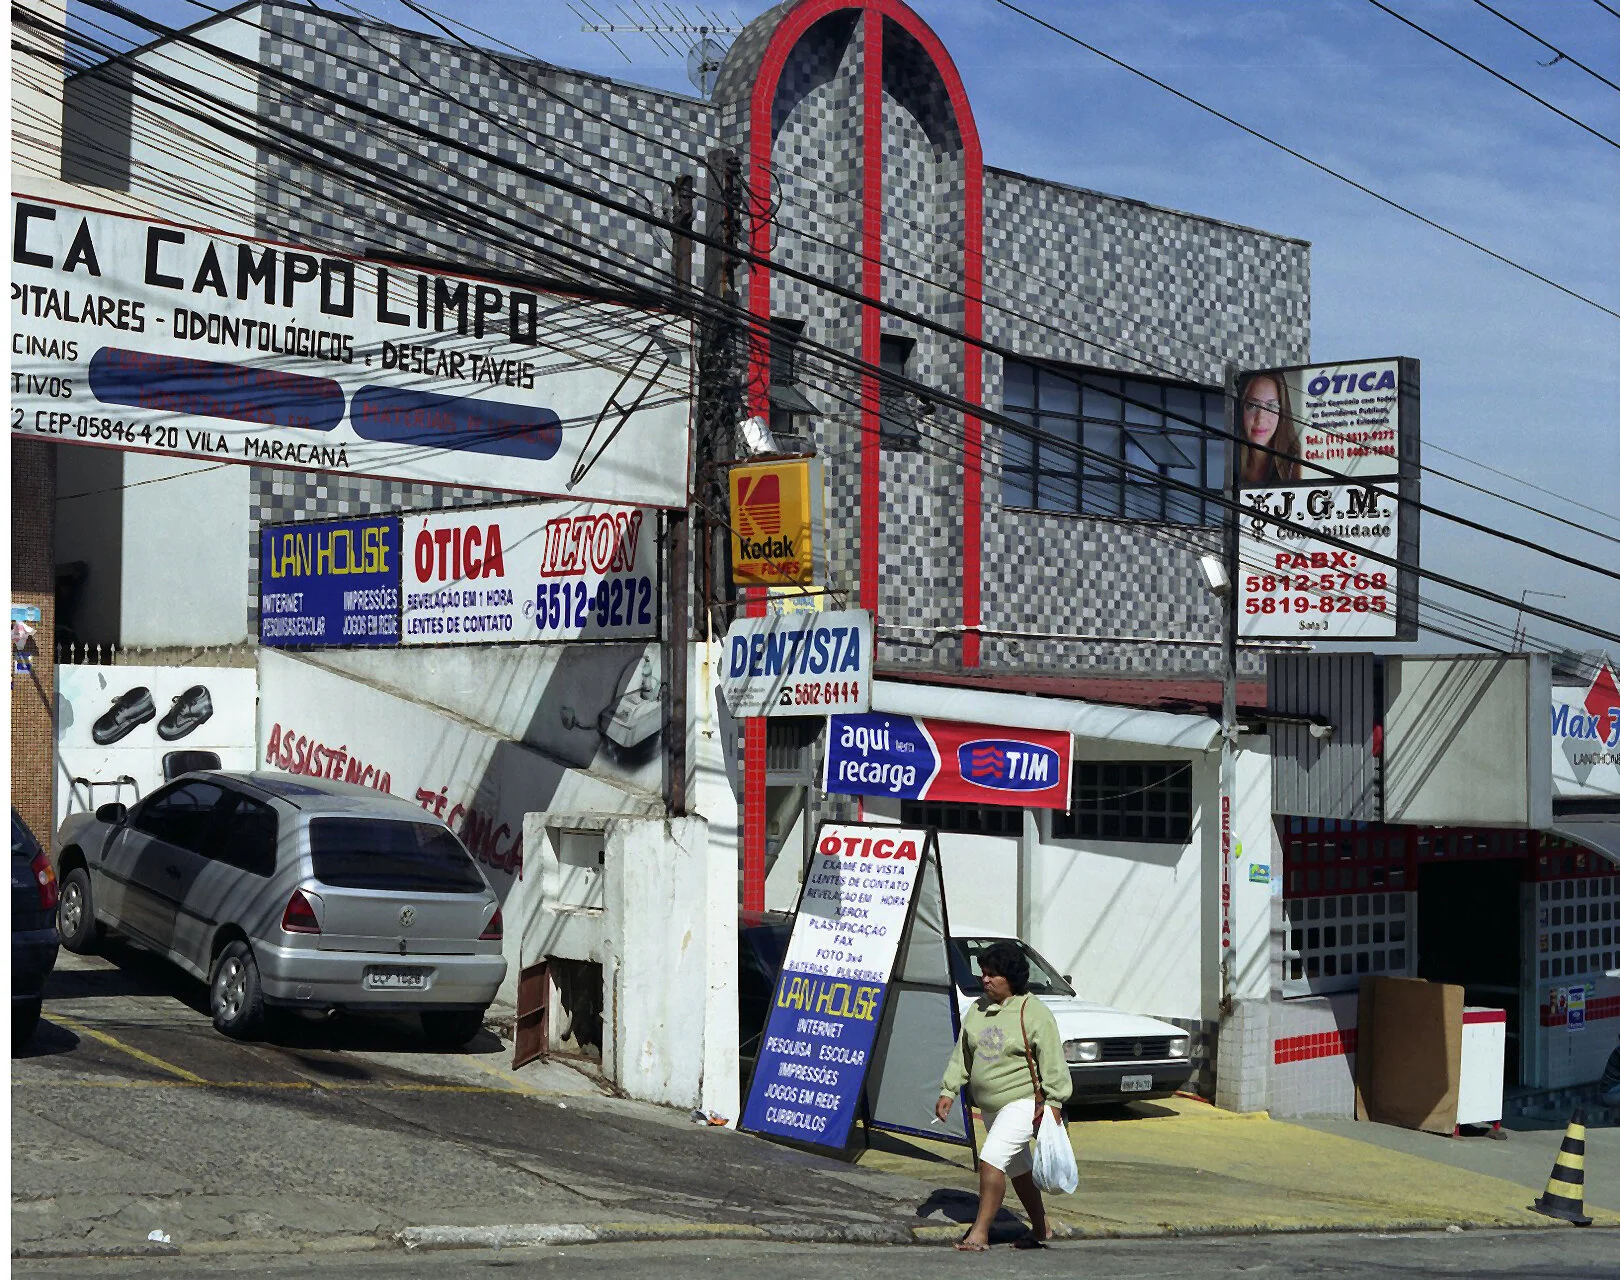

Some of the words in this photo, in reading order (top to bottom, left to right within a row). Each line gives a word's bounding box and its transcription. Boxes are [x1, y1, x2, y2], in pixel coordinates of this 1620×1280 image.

[13, 202, 101, 277] CA
[144, 226, 354, 318] CAMPO
[377, 268, 537, 346] LIMPO
[13, 333, 78, 362] CINAIS
[173, 308, 353, 364] ODONTOLÓGICOS
[382, 340, 534, 389] DESCARTÁVEIS
[1307, 369, 1396, 396] ÓTICA
[187, 428, 229, 454] VILA
[244, 436, 349, 468] MARACANÃ
[1273, 489, 1392, 520] J.G.M.
[1276, 522, 1392, 540] Cobilidade
[271, 532, 312, 578] LAN
[316, 526, 390, 576] HOUSE
[414, 518, 505, 583] ÓTICA
[540, 510, 643, 578] ILTON
[740, 534, 794, 560] Kodak
[1275, 551, 1357, 569] PABX:
[1245, 572, 1387, 592] 5812-5768
[262, 592, 304, 613] INTERNET
[343, 585, 398, 611] IMPRESSÕES
[462, 590, 477, 607] EM
[486, 589, 514, 606] HORA
[536, 576, 651, 630] 5512-9272
[1245, 595, 1387, 615] 5819-8265
[407, 617, 444, 635] LENTES
[446, 616, 460, 633] DE
[463, 613, 513, 633] CONTATO
[730, 627, 860, 678] DENTISTA
[1551, 703, 1601, 740] Max
[840, 722, 890, 757] aqui
[895, 740, 915, 753] tem
[266, 722, 391, 794] ASSISTÊNCIA
[1006, 751, 1049, 782] TIM
[839, 760, 916, 792] recarga
[415, 785, 524, 881] TÉCNICA
[819, 831, 917, 861] ÓTICA
[822, 860, 857, 873] EXAME
[860, 862, 872, 873] DE
[876, 864, 905, 875] VISTA
[1221, 796, 1231, 934] DENTISTA
[811, 873, 846, 886] LENTES
[848, 876, 860, 888] DE
[863, 879, 909, 891] CONTATO
[834, 906, 870, 919] XEROX
[858, 892, 872, 903] EM
[880, 895, 905, 906] HORA
[816, 948, 844, 962] FOTO
[834, 935, 854, 946] FAX
[777, 976, 817, 1012] LAN
[815, 981, 881, 1021] HOUSE
[796, 1018, 844, 1038] INTERNET
[766, 1036, 812, 1058] PESQUISA
[818, 1044, 865, 1065] ESCOLAR
[778, 1061, 840, 1086] IMPRESSÕES
[764, 1083, 799, 1103] JOGOS
[798, 1088, 815, 1104] EM
[815, 1091, 841, 1110] REDE
